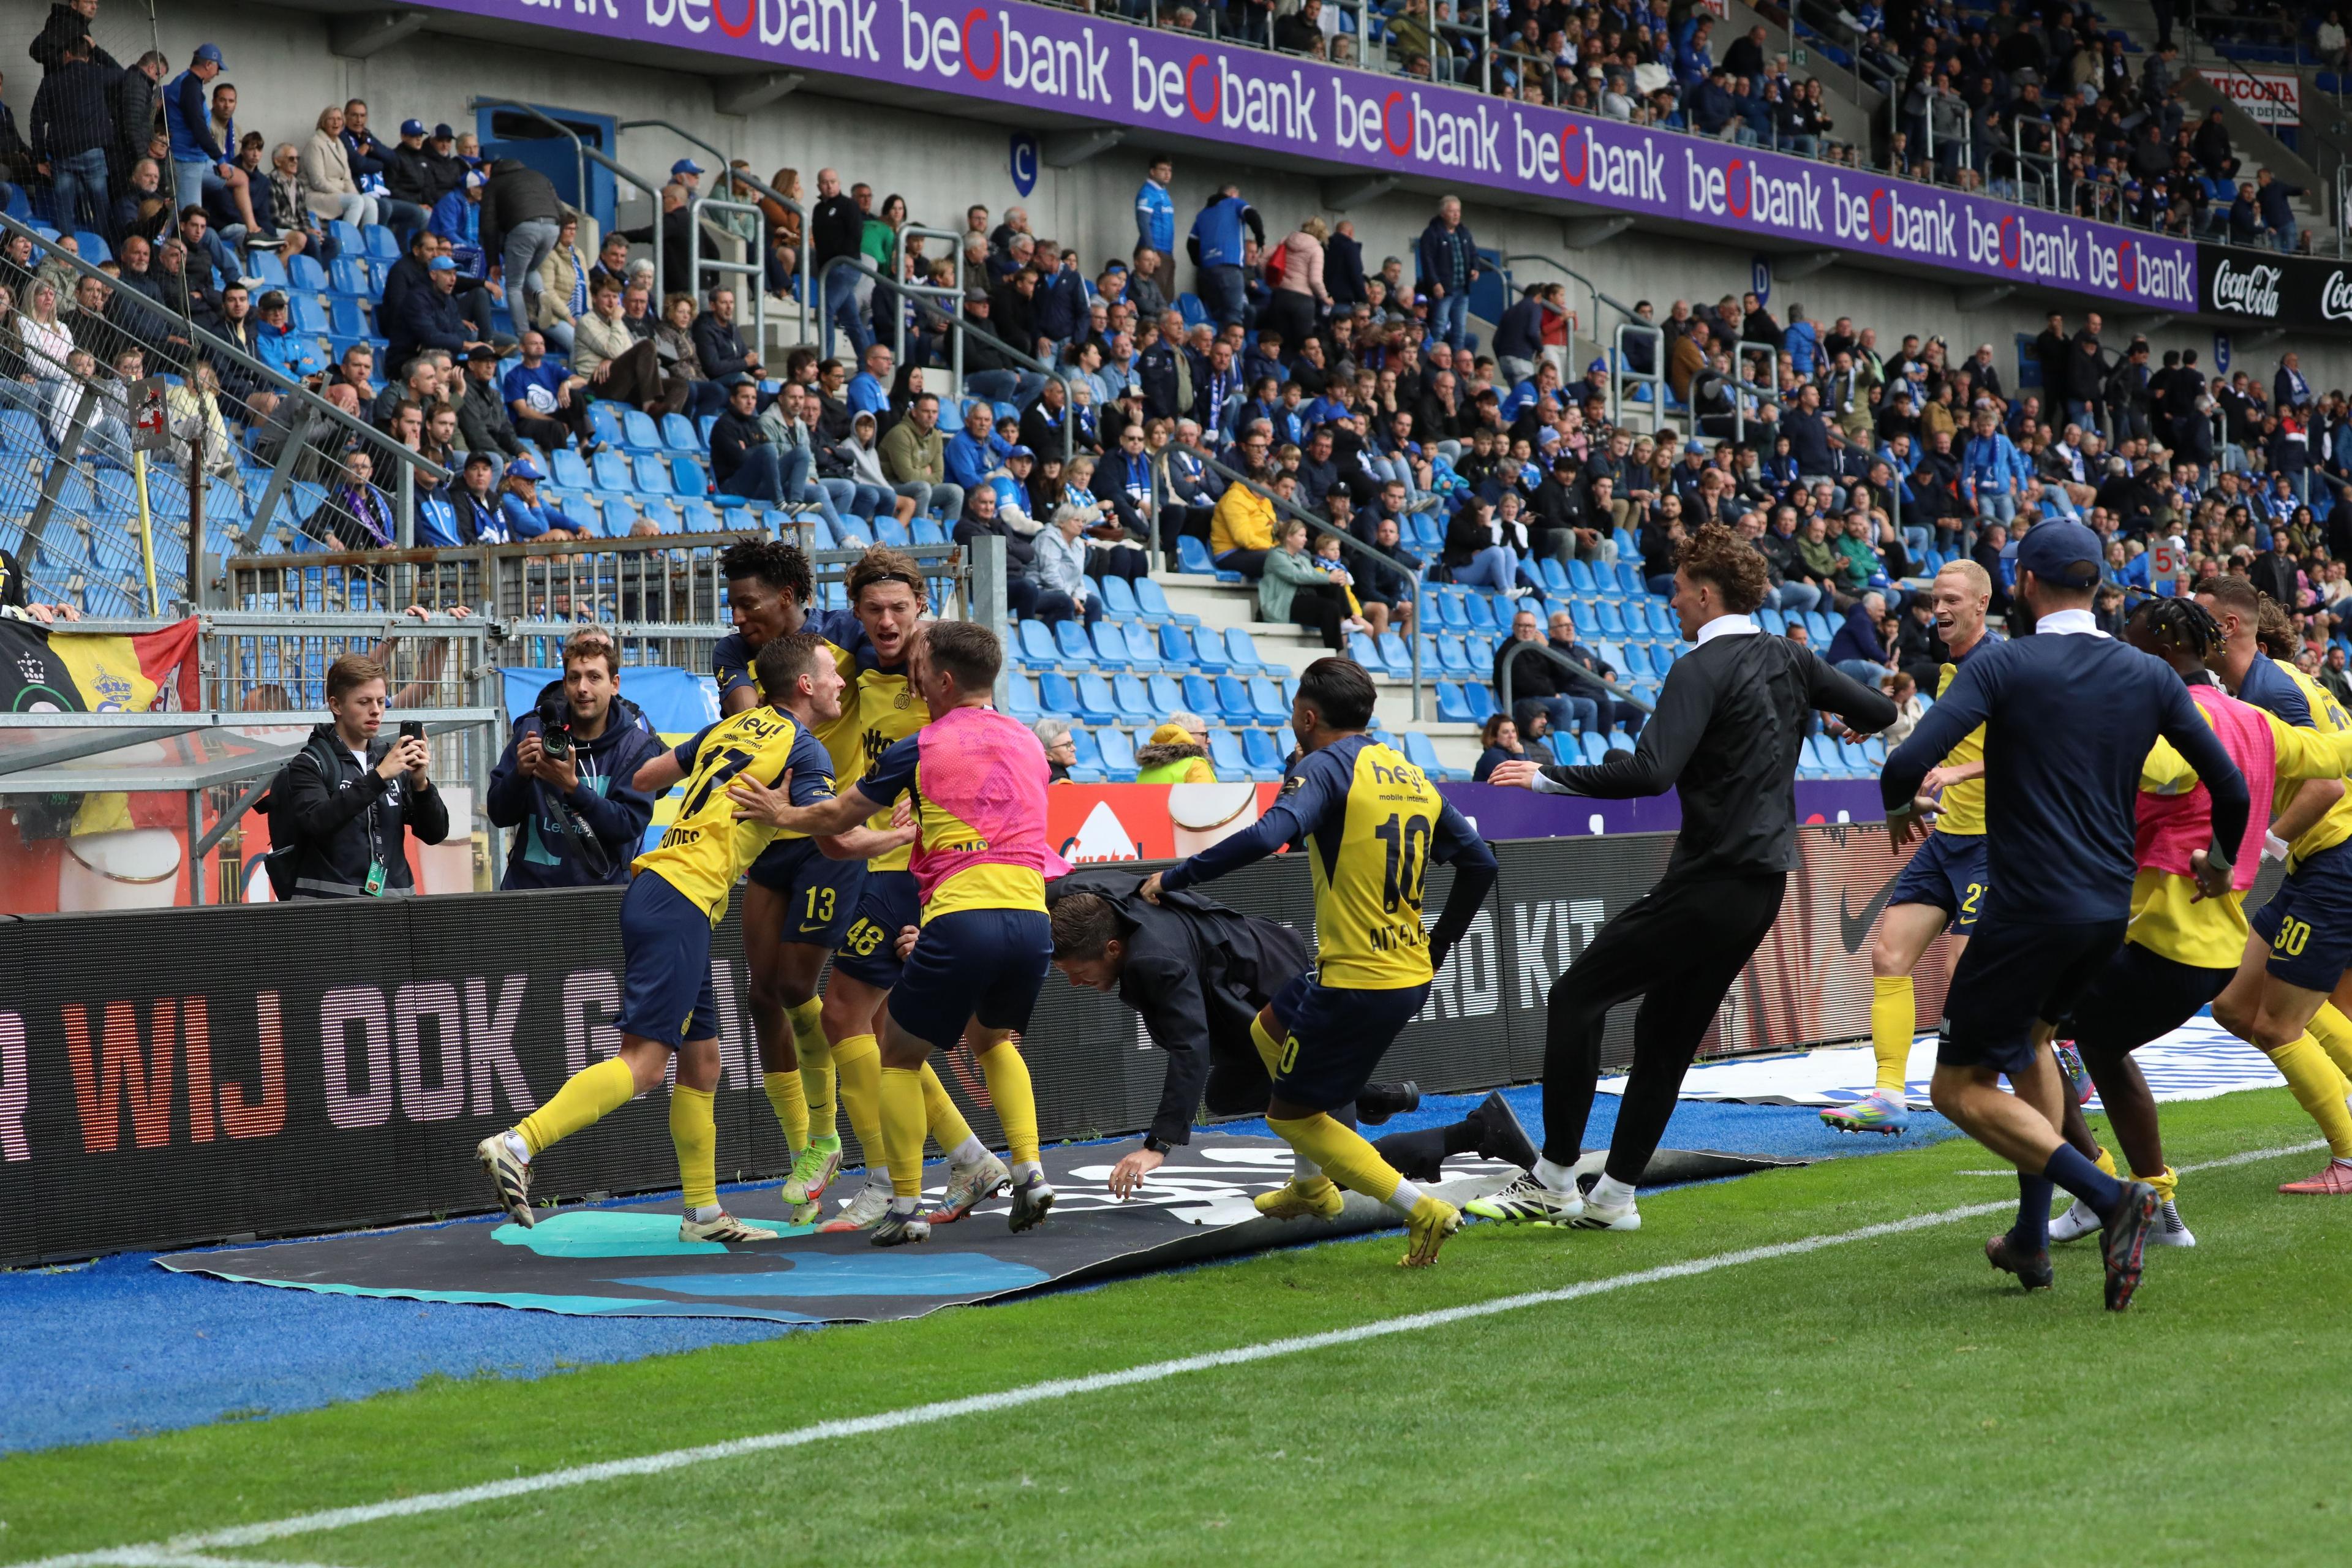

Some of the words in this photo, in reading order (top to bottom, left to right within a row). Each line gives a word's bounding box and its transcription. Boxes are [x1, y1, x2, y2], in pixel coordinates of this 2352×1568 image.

[1016, 143, 1031, 181] C
[1756, 264, 1768, 294] D
[2213, 258, 2283, 317] Coca-Cola
[2218, 338, 2227, 364] E
[2155, 547, 2173, 574] 5
[733, 714, 786, 739] hey!
[679, 744, 756, 820] 17
[1370, 761, 1424, 794] hey!
[1407, 795, 1429, 804] internet
[577, 816, 593, 838] SONY
[1375, 813, 1431, 915] 10
[805, 886, 836, 922] 13
[1962, 883, 1988, 913] 2
[846, 916, 885, 956] 48
[1370, 925, 1398, 952] AIT
[2274, 915, 2311, 956] 30
[1514, 899, 1605, 1009] KIT
[61, 990, 286, 1153] WIJ
[320, 974, 538, 1129] OOK
